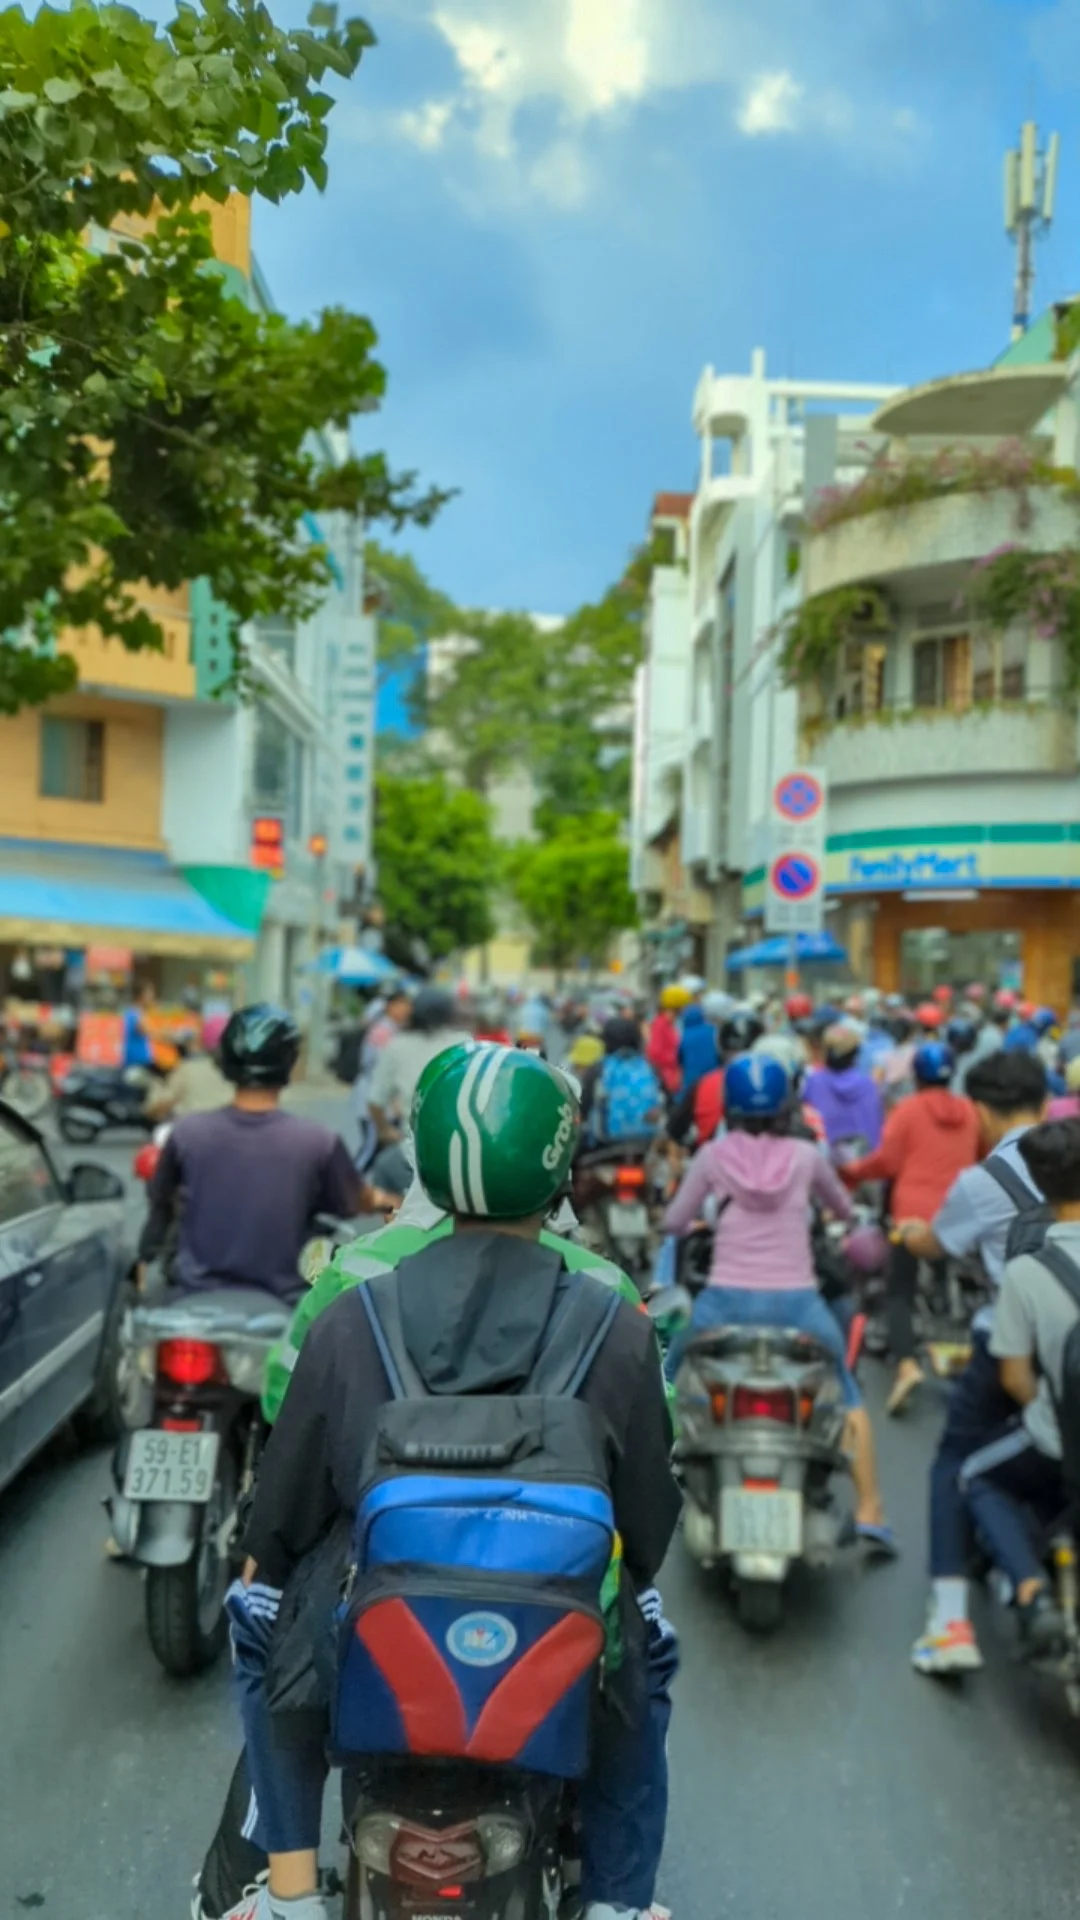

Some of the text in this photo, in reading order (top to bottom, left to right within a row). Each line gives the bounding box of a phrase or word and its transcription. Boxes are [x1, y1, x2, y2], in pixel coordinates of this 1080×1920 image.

[850, 851, 976, 884] FamilyMart
[542, 1102, 573, 1170] Grab
[144, 1437, 201, 1465] 59-E1
[132, 1467, 208, 1496] 371.59
